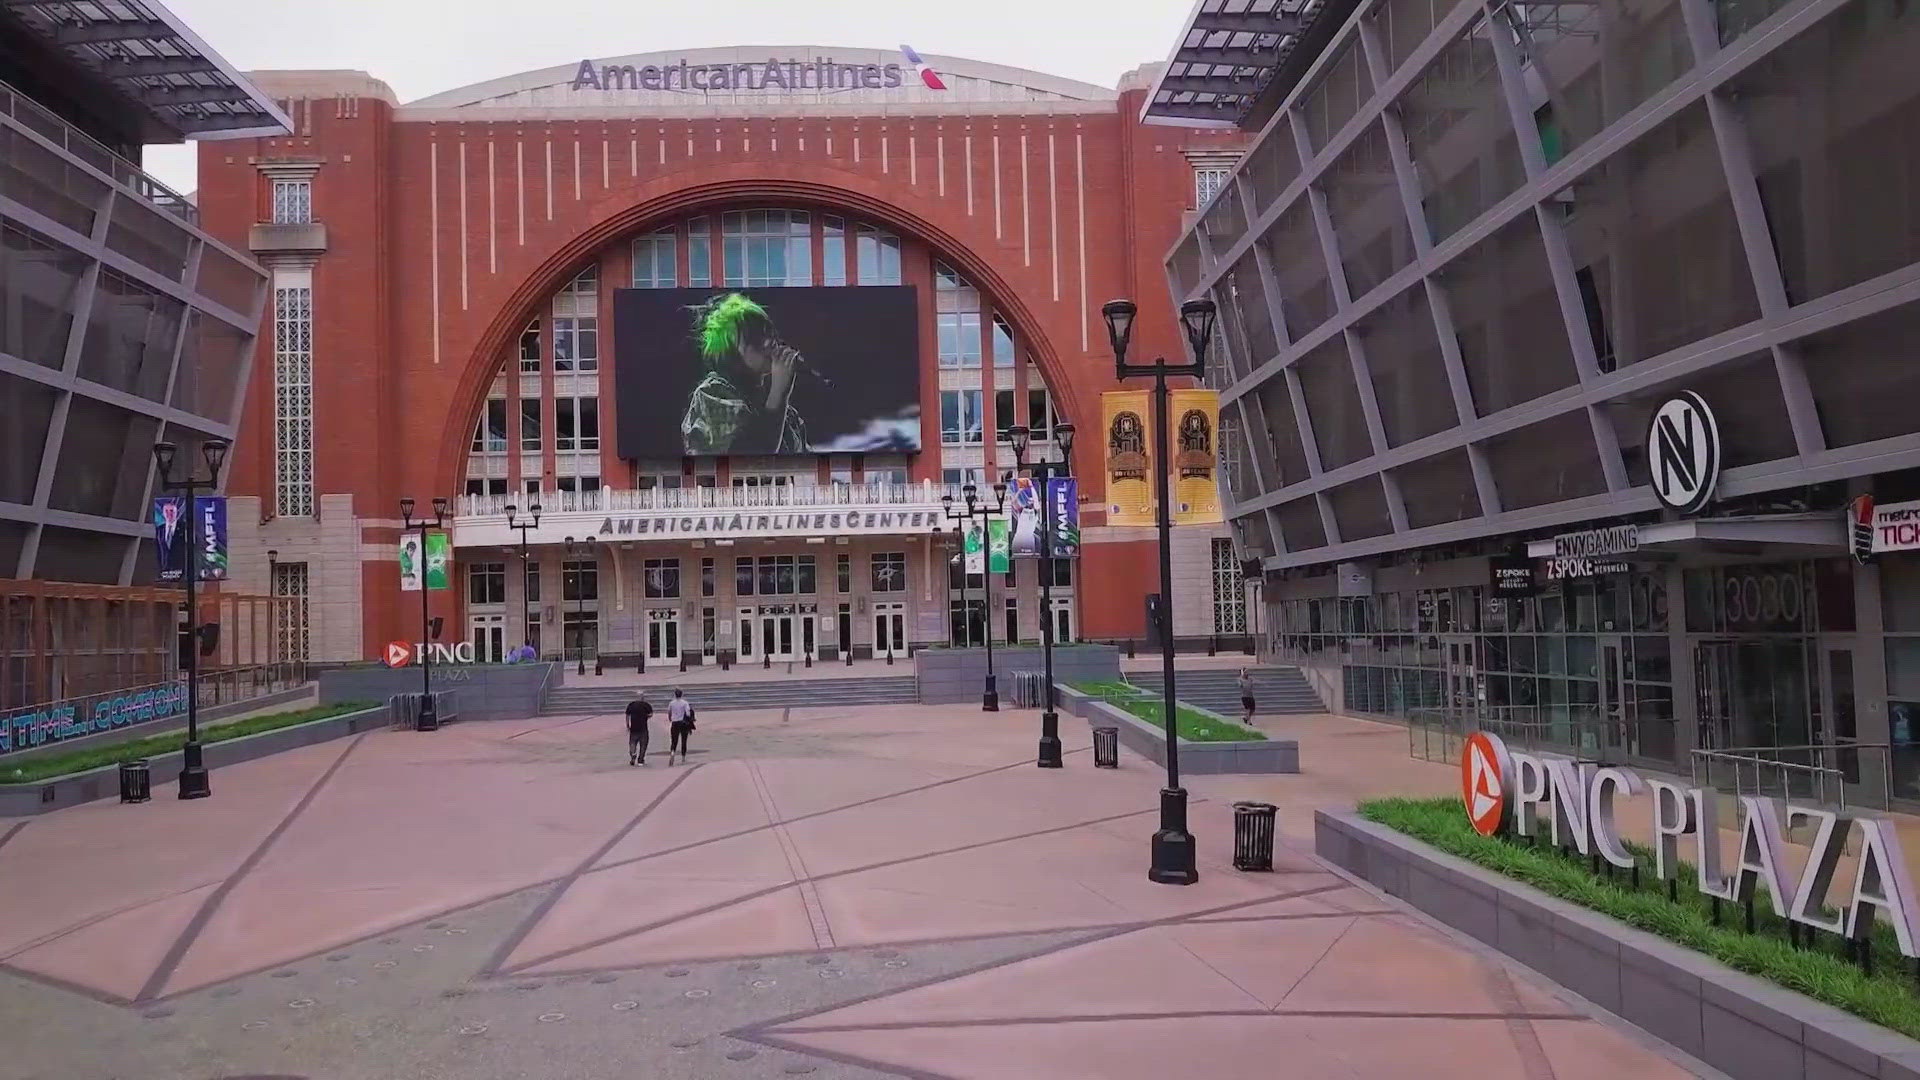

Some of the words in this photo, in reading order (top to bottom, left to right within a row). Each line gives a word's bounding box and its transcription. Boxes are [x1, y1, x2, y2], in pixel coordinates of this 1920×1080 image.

[414, 642, 475, 665] PNC
[1511, 752, 1641, 868] PNC
[1648, 778, 1920, 959] PLAZA
